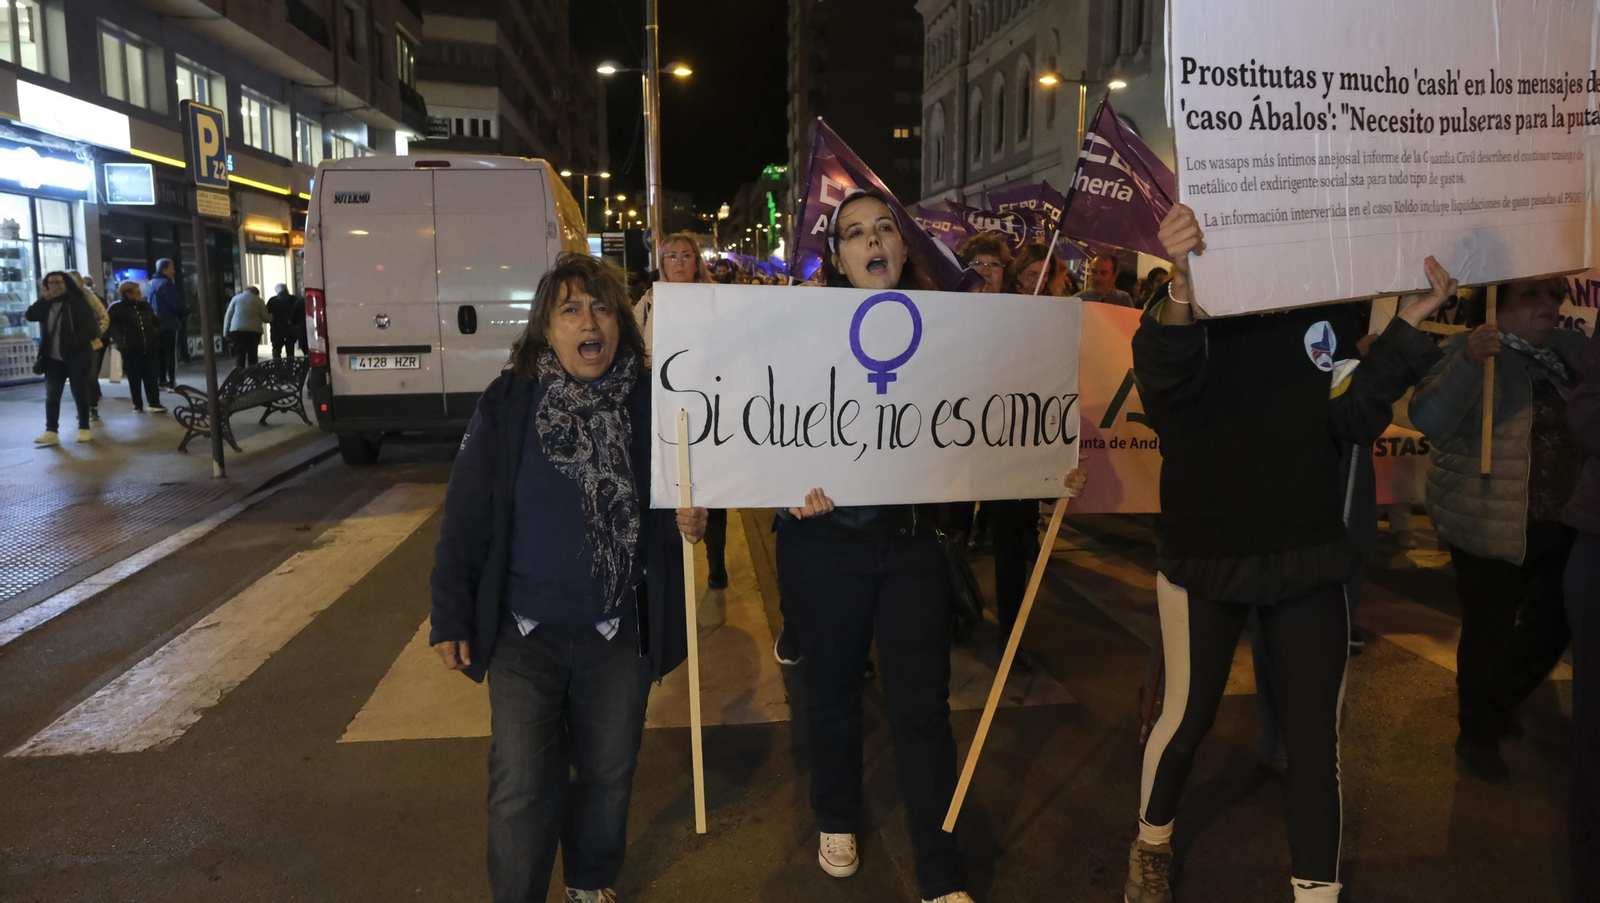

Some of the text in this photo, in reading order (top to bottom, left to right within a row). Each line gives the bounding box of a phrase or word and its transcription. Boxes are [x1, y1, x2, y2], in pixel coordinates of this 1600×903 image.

[1180, 56, 1317, 89] Prostitutas
[1322, 71, 1334, 99] y
[1339, 66, 1410, 94] mucho
[1414, 68, 1461, 96] 'cash'
[1464, 77, 1486, 96] en
[1489, 69, 1513, 95] los
[1517, 71, 1583, 102] mensajes
[1180, 97, 1243, 131] 'caso
[1249, 94, 1337, 131] Ábalos':
[1341, 102, 1435, 134] "Necesito
[1439, 106, 1511, 136] pulseras
[1515, 111, 1548, 135] para
[1551, 104, 1565, 128] la
[196, 113, 219, 177] P
[213, 160, 226, 180] Z2
[1186, 156, 1207, 171] Los
[1209, 157, 1250, 174] wasaps
[1252, 153, 1275, 168] más
[1277, 153, 1316, 167] íntimos
[1318, 152, 1350, 169] anejos
[1352, 150, 1361, 165] al
[1363, 150, 1399, 165] informe
[1401, 150, 1413, 164] de
[1413, 150, 1422, 163] la
[1457, 150, 1476, 164] Civil
[1477, 150, 1512, 164] describen
[1513, 150, 1520, 162] el
[1188, 177, 1238, 195] metálico
[1240, 176, 1257, 192] del
[1260, 175, 1318, 194] exdirigente
[1320, 172, 1365, 188] socialista
[1366, 174, 1387, 190] para
[1388, 171, 1409, 185] todo
[1410, 172, 1427, 188] tipo
[1203, 212, 1218, 227] La
[1221, 209, 1289, 226] información
[1348, 204, 1361, 216] en
[1362, 201, 1371, 216] el
[1372, 203, 1392, 214] caso
[1394, 199, 1418, 213] Koldo
[1420, 199, 1449, 216] incluye
[1451, 197, 1500, 214] liquidaciones
[1501, 195, 1511, 208] de
[1511, 197, 1530, 211] gasto
[1531, 192, 1556, 209] pasadas
[1557, 192, 1564, 204] al
[359, 357, 416, 368] 4128 HZR
[658, 349, 734, 447] Si
[743, 365, 868, 462] duele,
[876, 403, 922, 450] no
[931, 396, 976, 449] es
[1109, 436, 1127, 449] de
[1130, 436, 1160, 449] And
